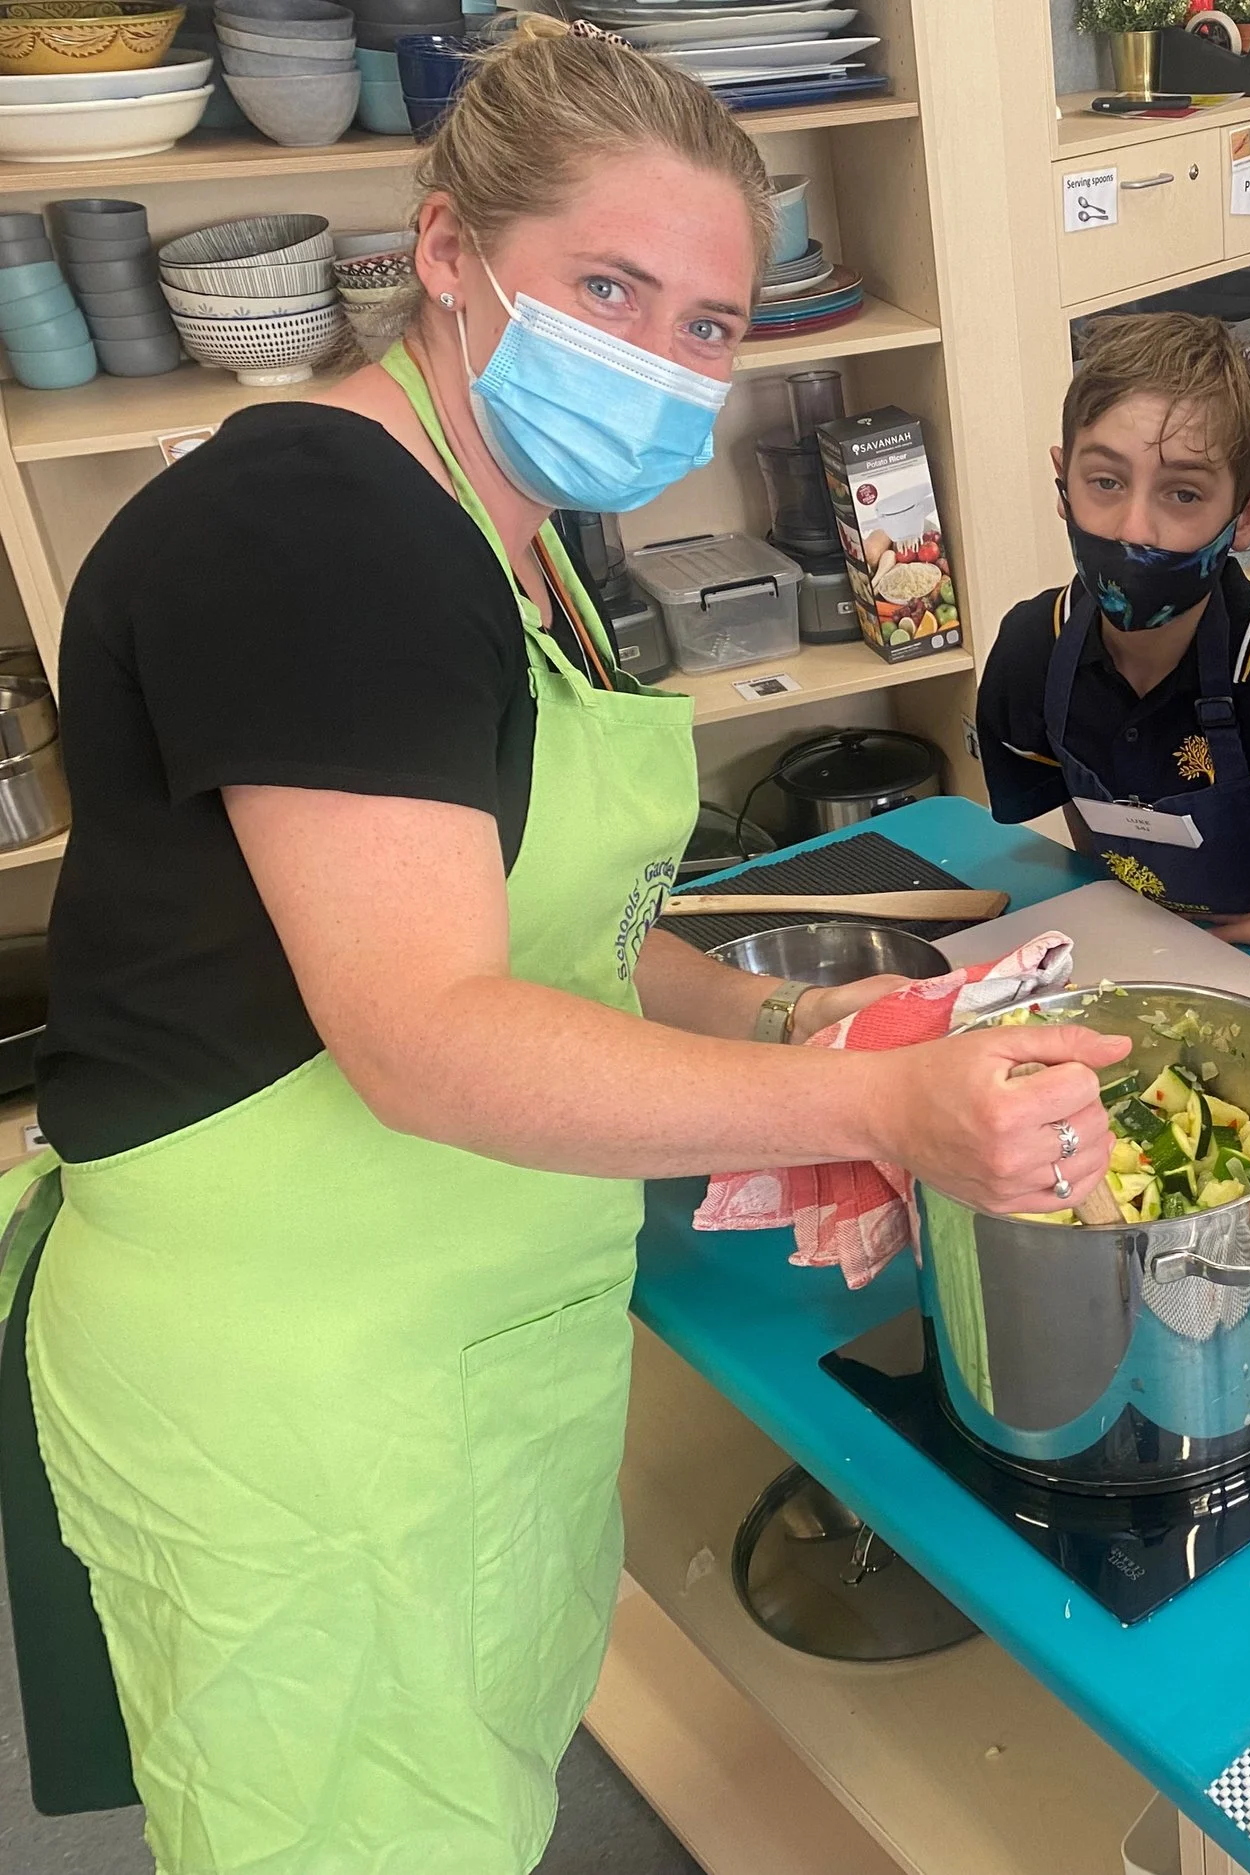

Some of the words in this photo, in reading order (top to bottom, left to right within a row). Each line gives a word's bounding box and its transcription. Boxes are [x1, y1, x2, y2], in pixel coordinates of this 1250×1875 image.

[1067, 177, 1091, 189] Serving
[1092, 174, 1114, 186] spoons
[860, 432, 911, 453] SAVANNAH
[866, 458, 888, 469] Potato
[888, 453, 907, 463] Ricer
